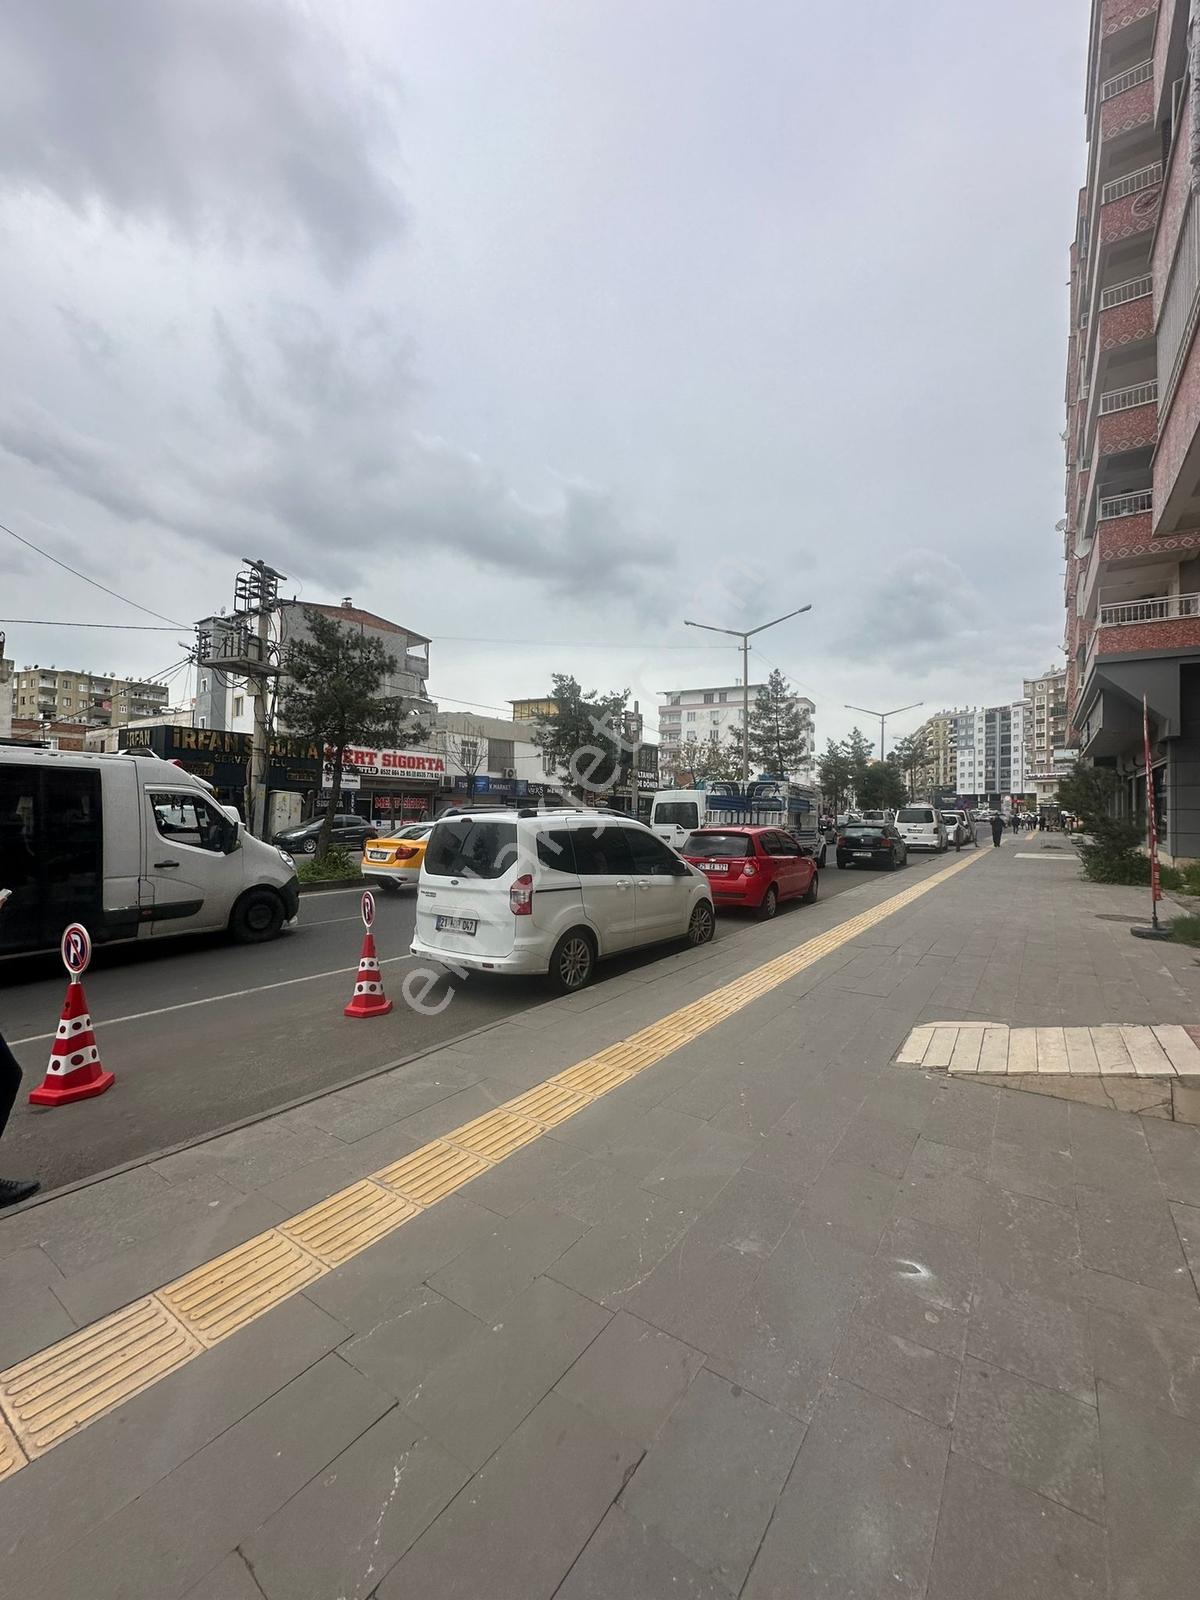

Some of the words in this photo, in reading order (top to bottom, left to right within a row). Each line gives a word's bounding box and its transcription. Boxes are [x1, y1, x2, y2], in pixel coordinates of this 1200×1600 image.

[244, 736, 318, 759] SORTA
[381, 751, 444, 773] SİGORTA
[375, 797, 400, 809] MET
